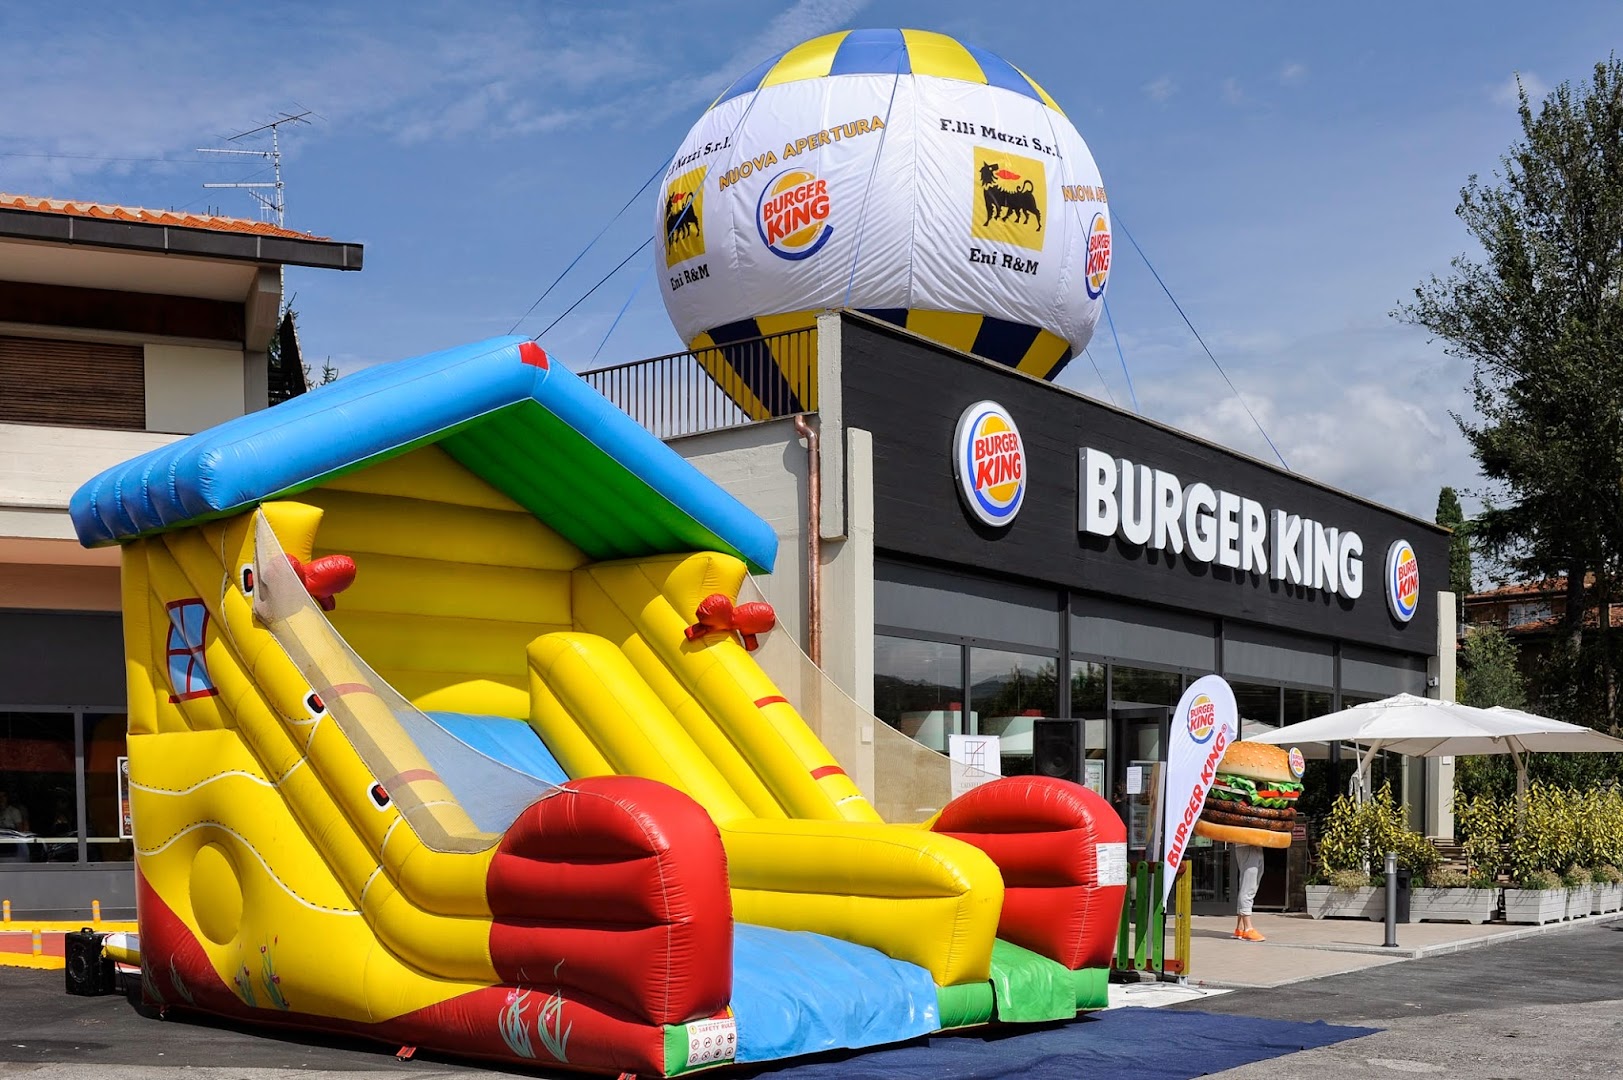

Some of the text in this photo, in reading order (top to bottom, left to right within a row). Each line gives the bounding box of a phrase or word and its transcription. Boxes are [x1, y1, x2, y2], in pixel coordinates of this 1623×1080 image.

[703, 136, 731, 156] S.r.l.
[940, 118, 976, 136] F.lli
[981, 125, 1029, 148] Mazzi
[719, 151, 778, 191] NUOVA
[783, 115, 885, 159] APERTURA
[763, 179, 827, 222] BURGER
[1061, 184, 1095, 203] NUOVA
[766, 195, 830, 246] KING
[969, 247, 1039, 275] Eni R&M
[670, 263, 710, 291] Eni R&M
[975, 433, 1019, 461] BURGER
[976, 452, 1021, 490] KING
[1078, 446, 1364, 600] BURGER KING
[1398, 559, 1417, 581] BURGE
[1189, 712, 1214, 732] KING
[1190, 703, 1214, 718] BURGER
[1167, 784, 1205, 869] BURGER
[698, 1024, 719, 1033] SAFETY
